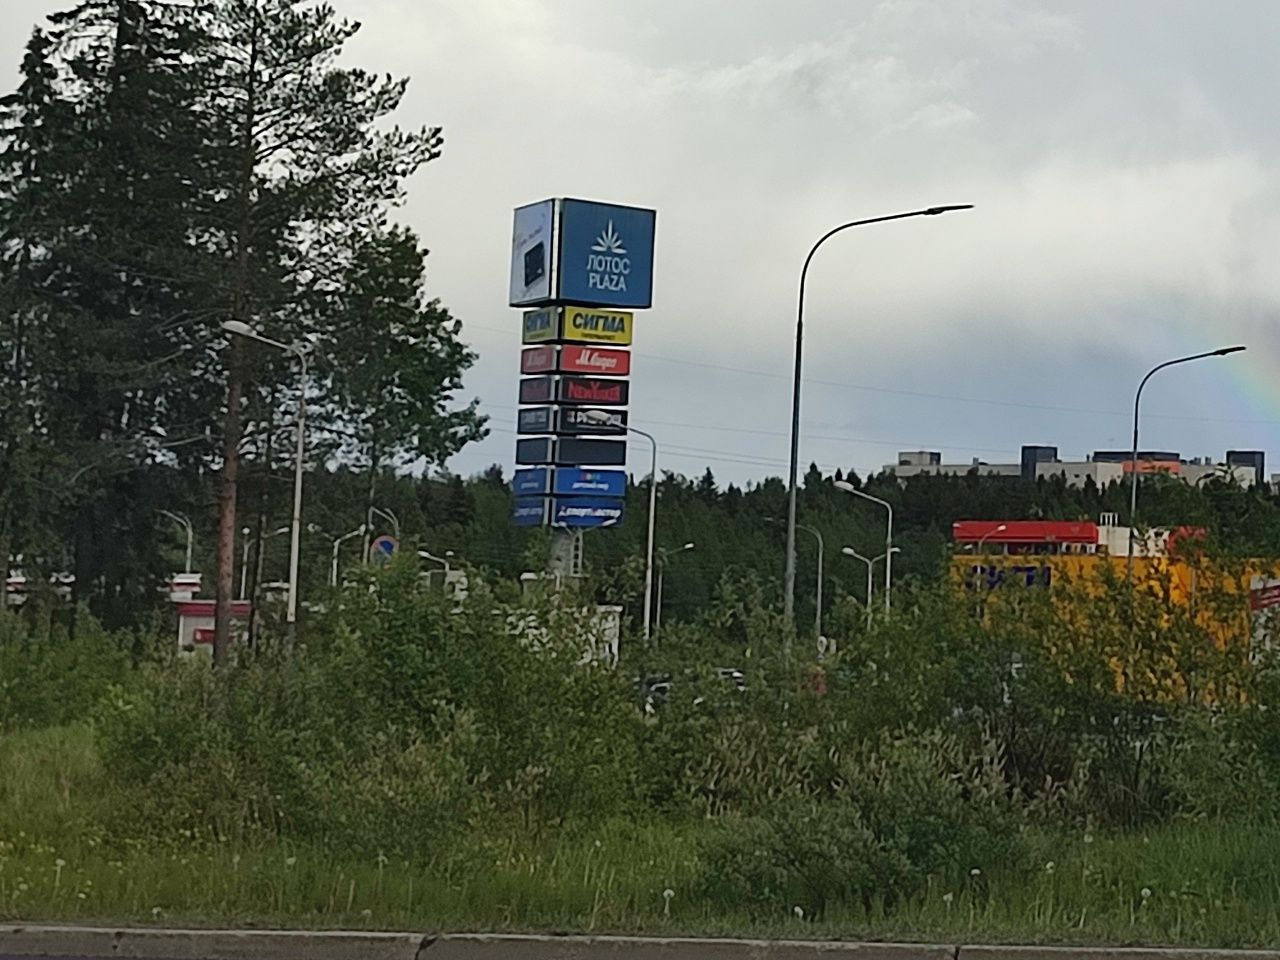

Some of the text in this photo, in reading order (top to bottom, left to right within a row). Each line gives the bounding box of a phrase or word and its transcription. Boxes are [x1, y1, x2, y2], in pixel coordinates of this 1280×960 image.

[587, 254, 630, 275] ЛОТОС
[588, 273, 627, 292] PLAZA
[572, 312, 625, 334] СИГМА
